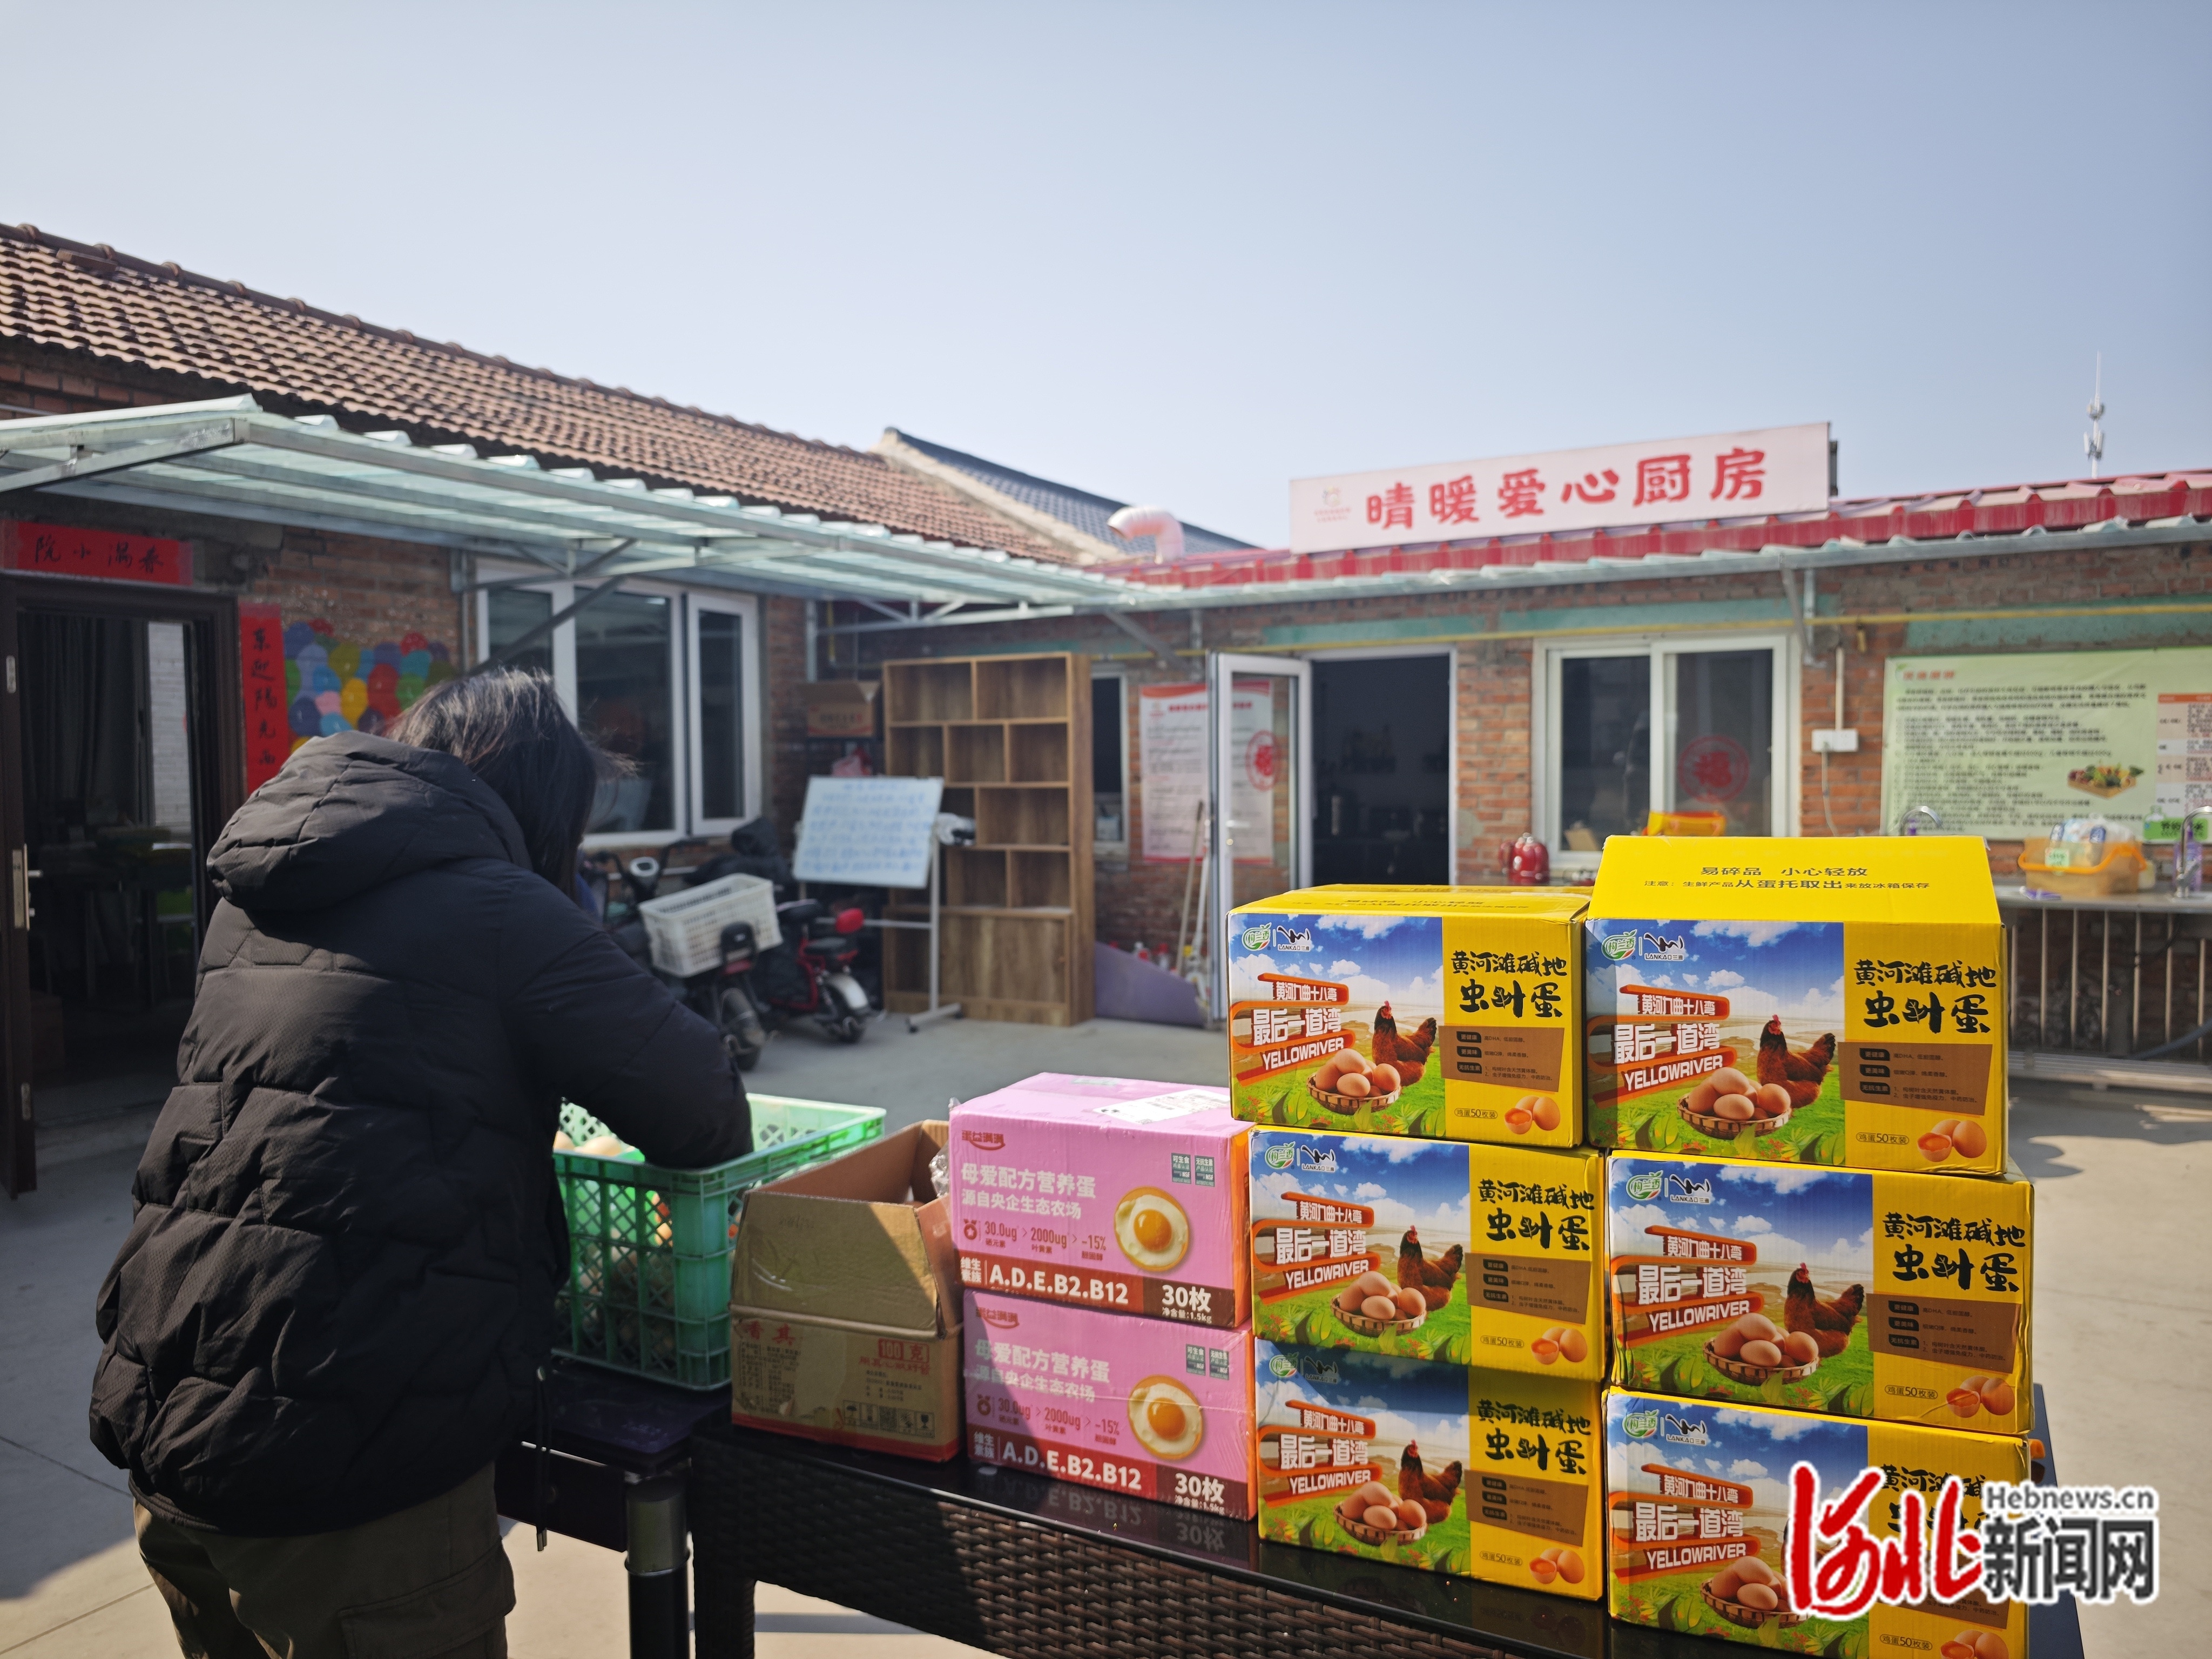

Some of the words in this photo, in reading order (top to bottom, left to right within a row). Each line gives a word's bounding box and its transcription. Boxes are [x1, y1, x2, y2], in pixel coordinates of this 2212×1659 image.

[1366, 447, 1766, 530] 晴暖爱心厨房
[2161, 820, 2203, 830] 节约水
[1700, 867, 1762, 876] 易碎品
[1781, 867, 1869, 876] 小心轻放
[1451, 950, 1567, 976] 黄河滩碱地
[1853, 959, 1997, 988] 黄河滩碱地
[1276, 981, 1337, 1001] 黄河九曲十八弯
[1642, 994, 1715, 1016] 黄河九曲十八弯
[1253, 1008, 1341, 1046] 最后一道湾
[1263, 1037, 1344, 1070] YELLOWRIVER
[1614, 1022, 1720, 1064] 最后一道湾
[1624, 1055, 1723, 1091] YELLOWRIVER
[1456, 1109, 1496, 1118] 鸡蛋50枚装
[1859, 1133, 1906, 1143] 鸡蛋50枚装
[961, 1162, 1096, 1199] 母爱配方营养蛋
[1478, 1178, 1595, 1210] 黄河滩碱地
[962, 1188, 1081, 1220] 源自央企生态农场
[1300, 1201, 1362, 1223] 黄河九曲十八弯
[1030, 1227, 1067, 1249] 2000ug
[1883, 1212, 2026, 1247] 黄河滩碱地
[1031, 1244, 1052, 1254] 叶黄素
[1276, 1228, 1366, 1264] 最后一道湾
[1668, 1236, 1742, 1260] 黄河九曲十八弯
[989, 1264, 1129, 1305] A.D.E.B2.B12
[1286, 1259, 1369, 1290] YELLOWRIVER
[1638, 1265, 1746, 1305] 最后一道湾
[1162, 1284, 1212, 1314] 30枚
[1649, 1300, 1749, 1332] YELLOWRIVER
[975, 1339, 1109, 1383] 母爱配方营养蛋
[1887, 1387, 1936, 1398] 鸡蛋50枚装
[1044, 1407, 1081, 1431] 2000ug
[1304, 1410, 1364, 1435] 黄河九曲十八弯
[1476, 1398, 1591, 1435] 黄河滩碱地
[1002, 1442, 1142, 1490] A.D.E.B2.B12
[1280, 1433, 1368, 1470] 最后一道湾
[1175, 1473, 1225, 1505] 30枚
[1290, 1469, 1371, 1495] YELLOWRIVER
[1664, 1474, 1738, 1503] 黄河九曲十八弯
[1880, 1464, 1986, 1499] 黄河滩碱
[1636, 1501, 1743, 1542] 最后一道湾
[1647, 1543, 1746, 1569] YELLOWRIVER
[1883, 1637, 1930, 1649] 鸡蛋50枚装
